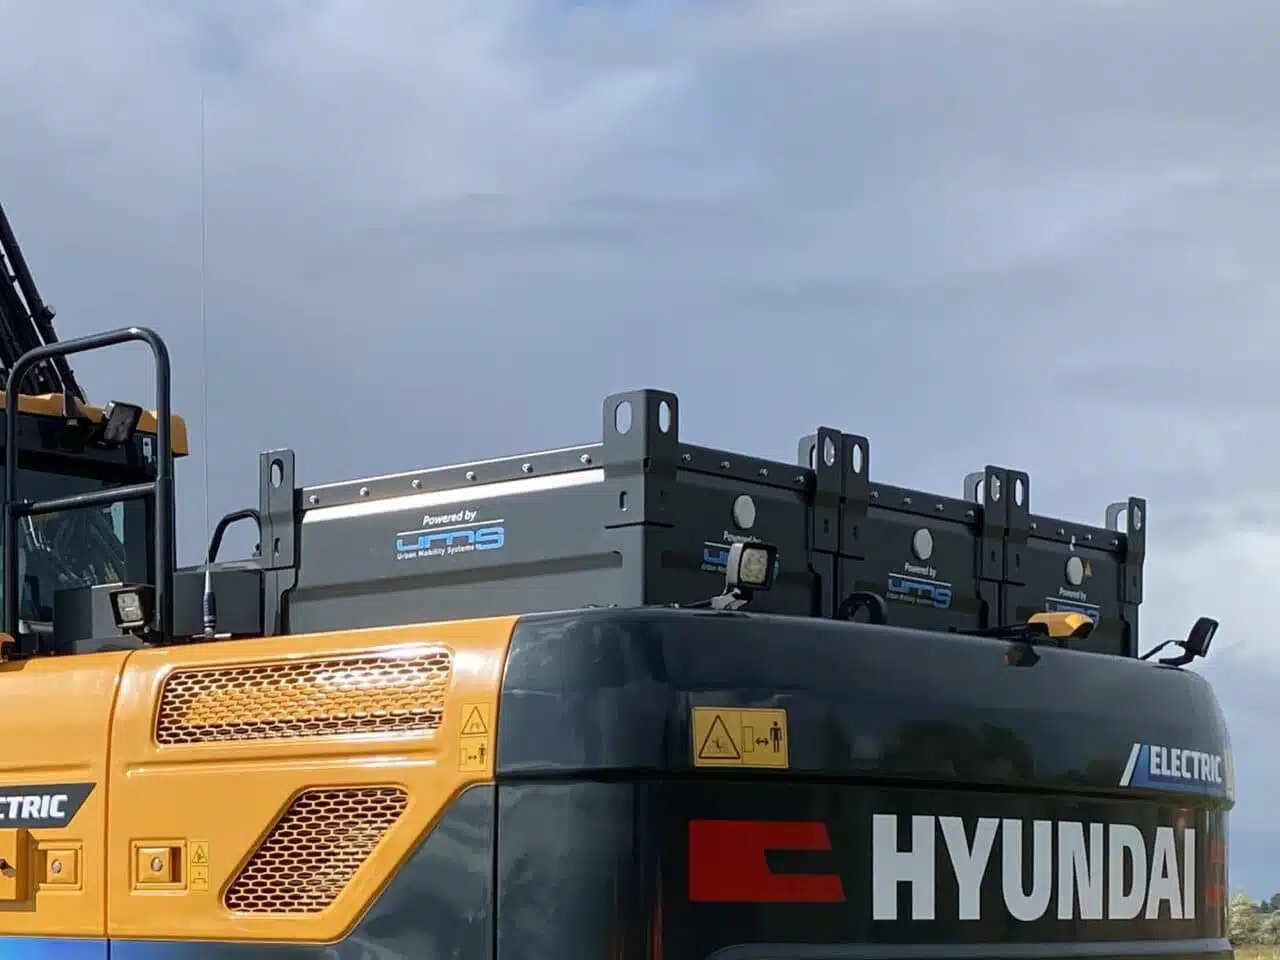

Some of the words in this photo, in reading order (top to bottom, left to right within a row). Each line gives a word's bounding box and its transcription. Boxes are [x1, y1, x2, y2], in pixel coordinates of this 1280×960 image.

[423, 511, 463, 526] Powered
[464, 510, 477, 522] by
[1150, 744, 1223, 784] ELECTRIC
[872, 813, 1196, 921] HYUNDAI
